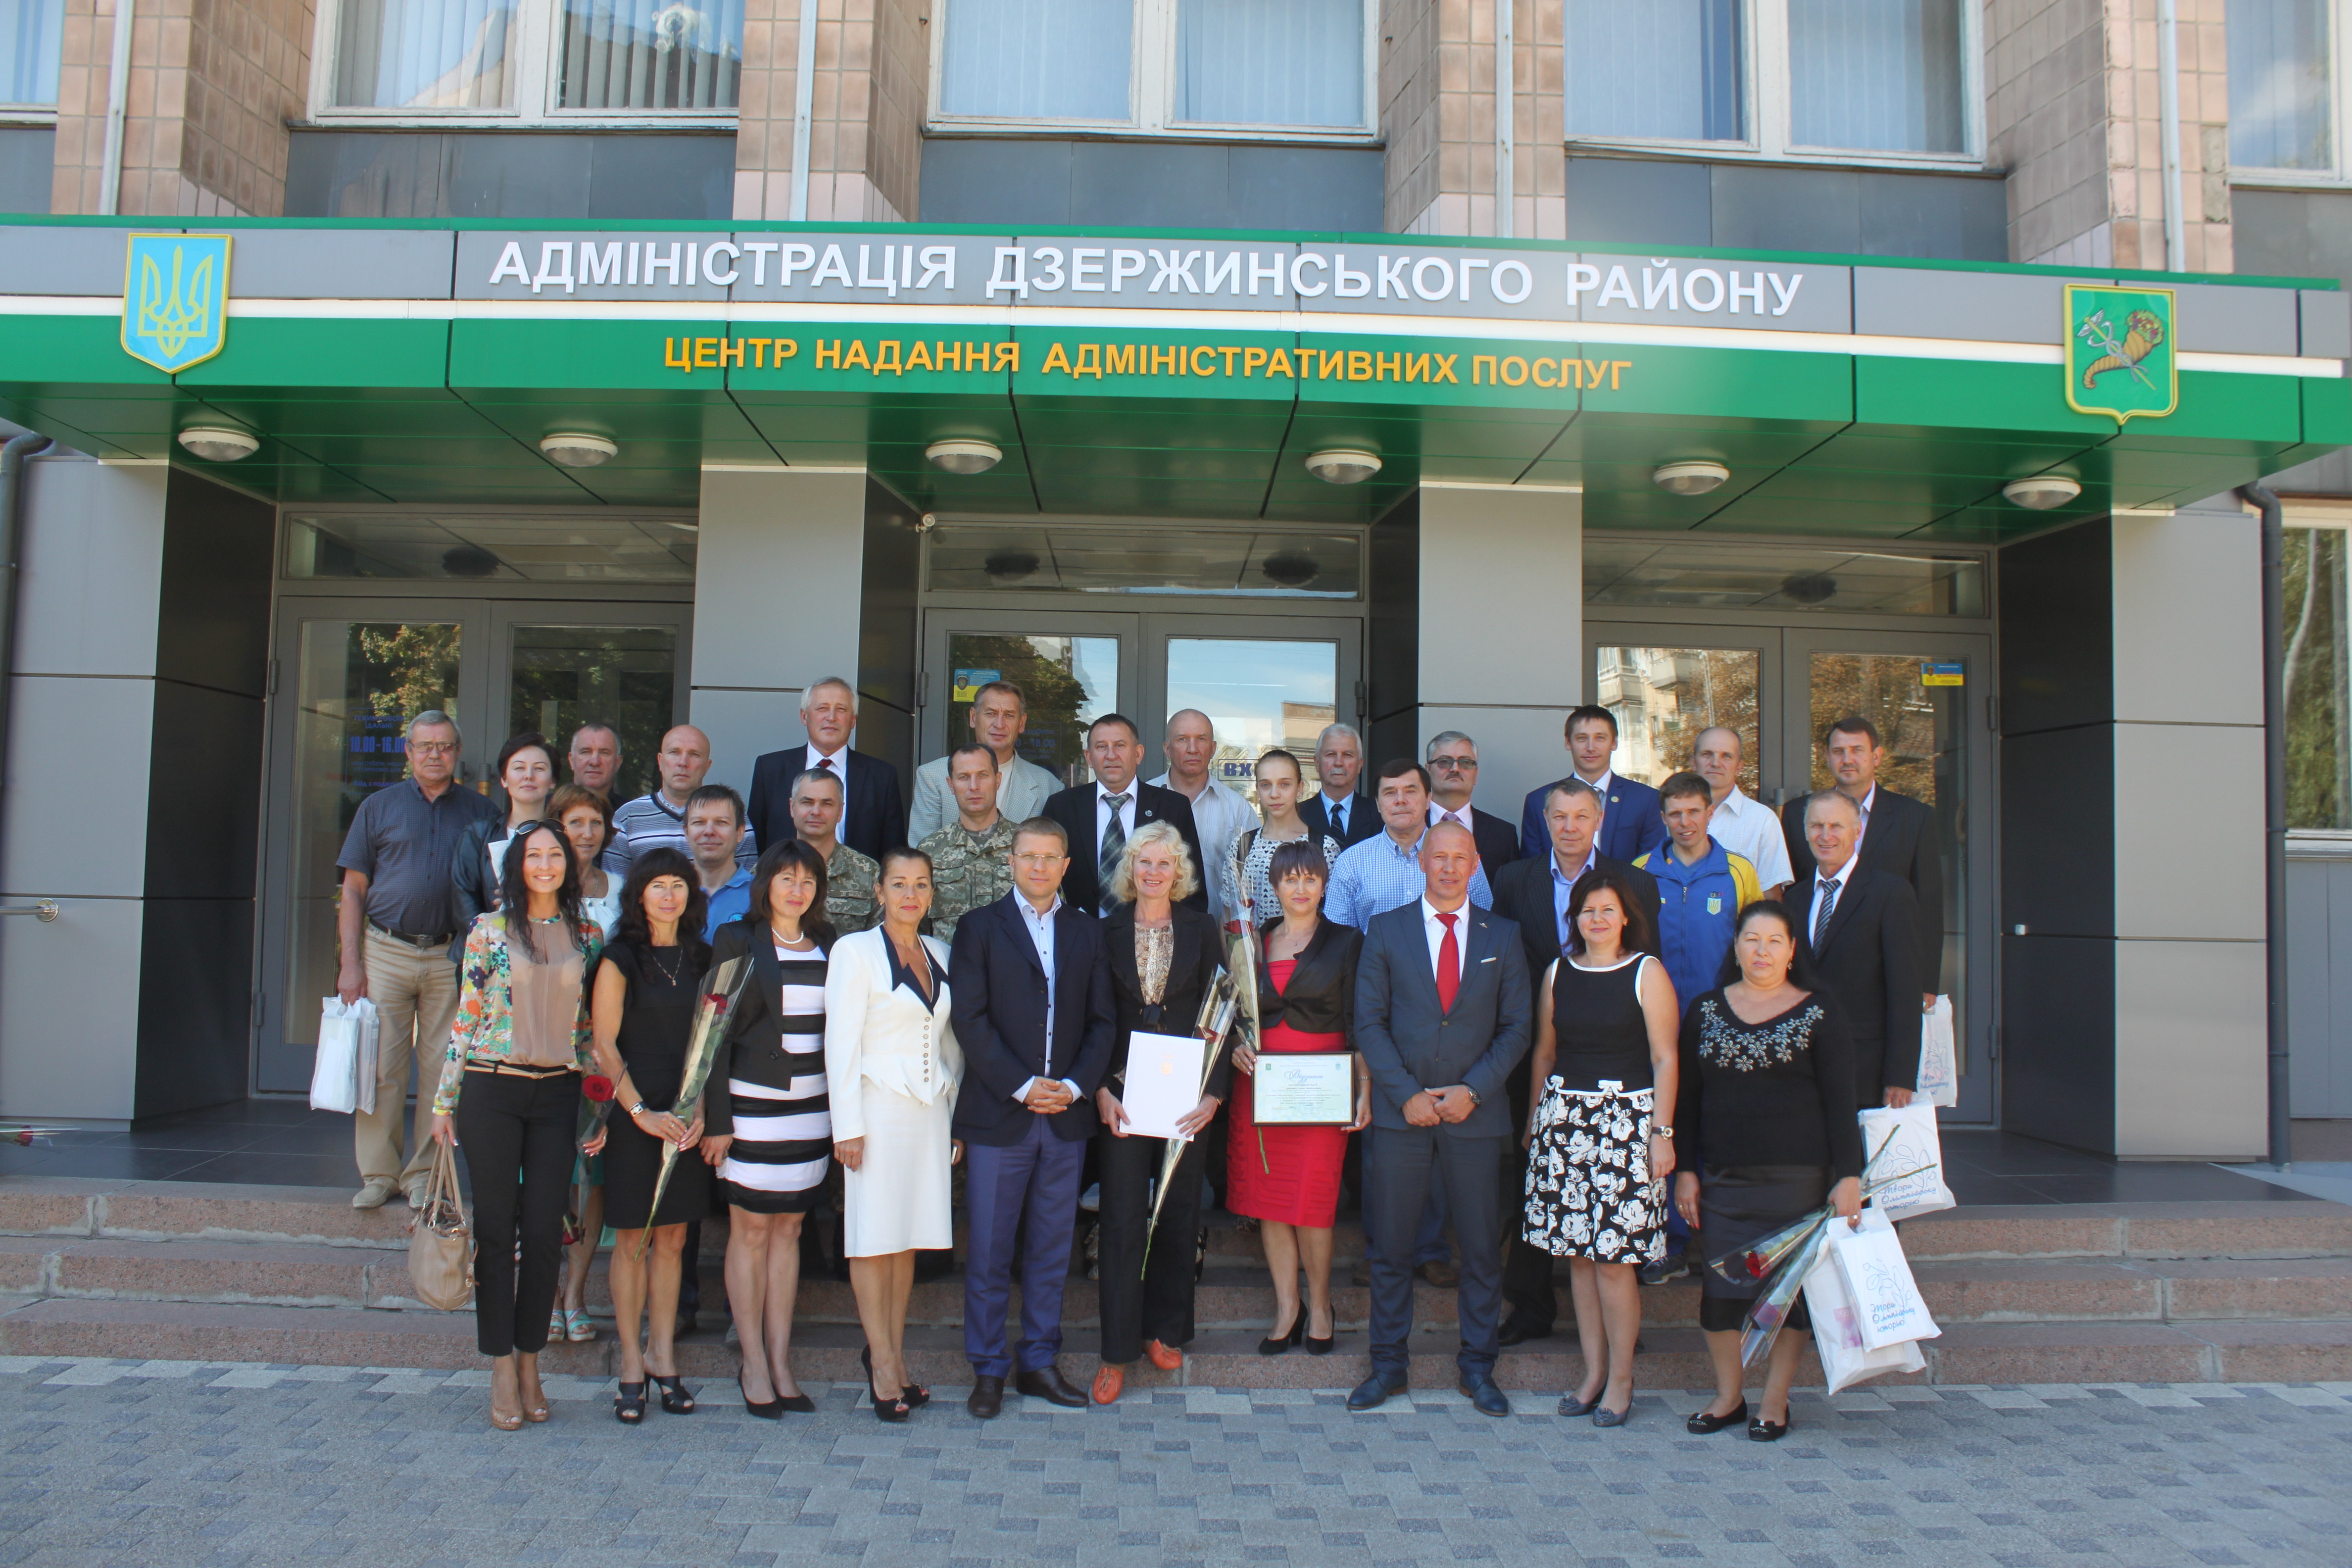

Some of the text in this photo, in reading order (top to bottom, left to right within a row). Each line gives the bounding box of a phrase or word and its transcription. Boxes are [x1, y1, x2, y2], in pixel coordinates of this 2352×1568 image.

[489, 241, 1804, 316] АДМІНІСТРАЦІЯ ДЗЕРЖИНСЬКОГО РАЙОНУ
[664, 337, 1632, 390] ЦЕНТР НАДАННЯ АДМІНІСТРАТИВНИХ ПОСЛУГ
[1225, 763, 1252, 776] ВХ
